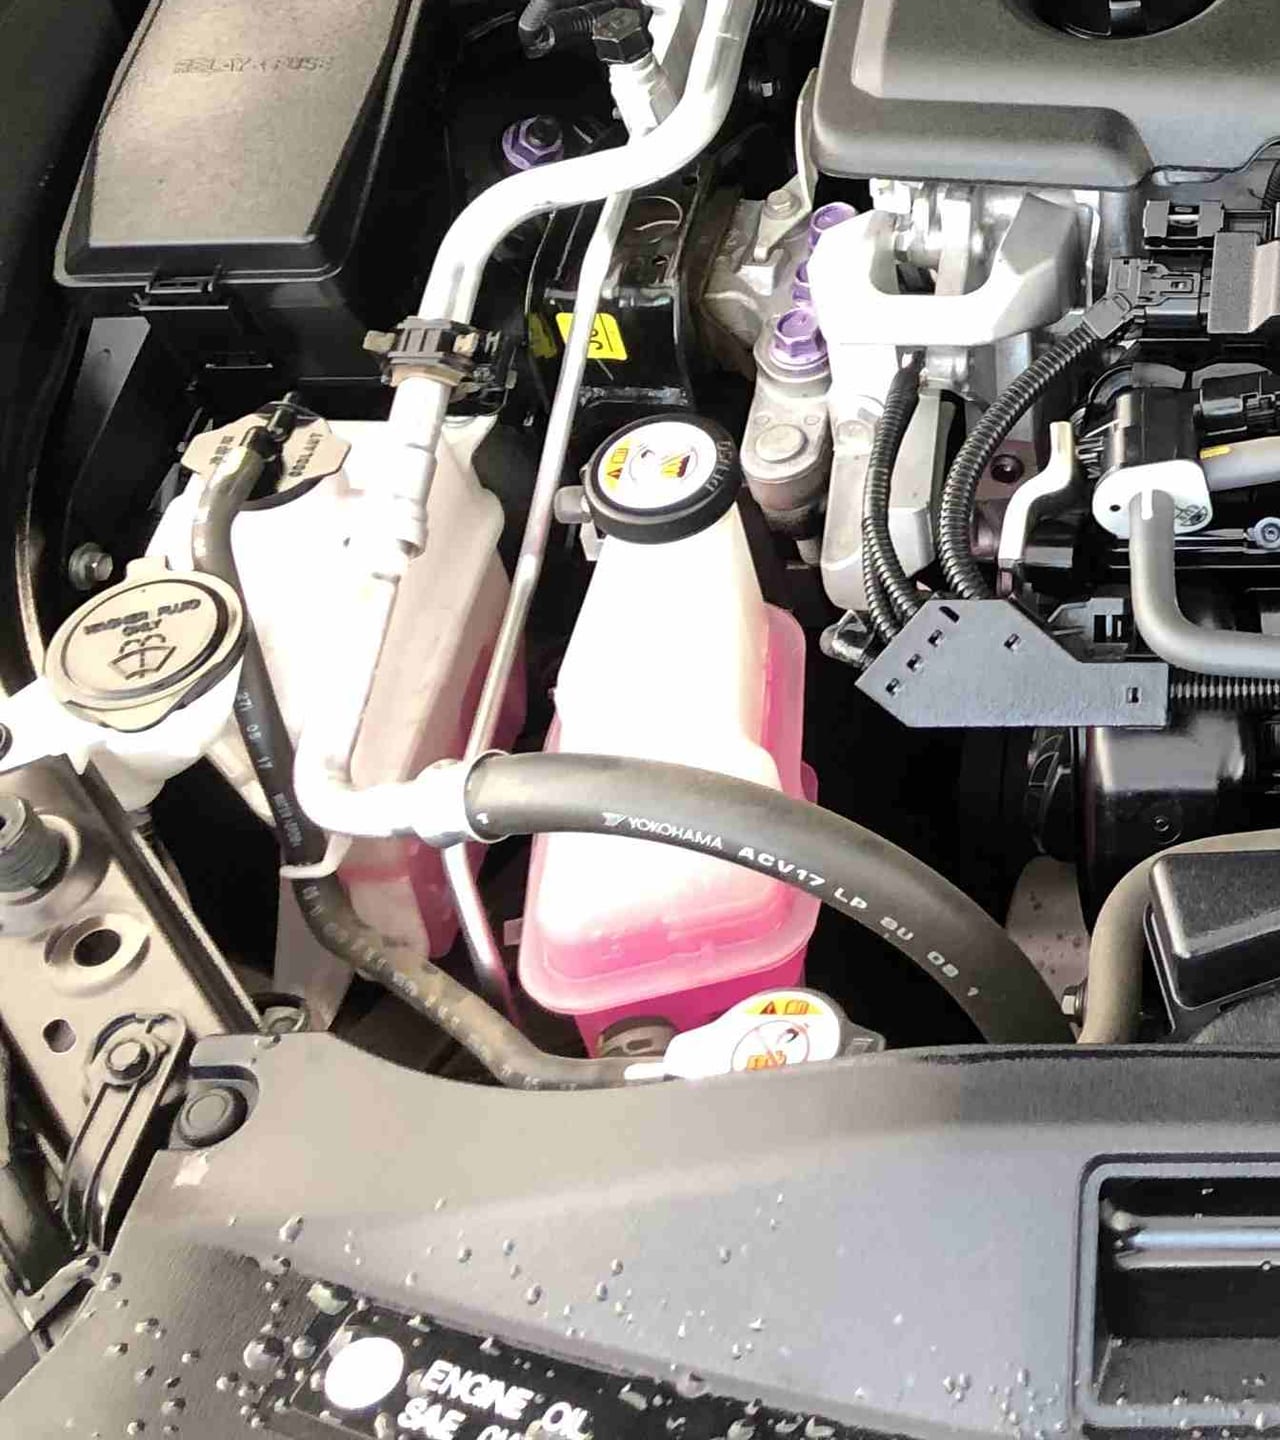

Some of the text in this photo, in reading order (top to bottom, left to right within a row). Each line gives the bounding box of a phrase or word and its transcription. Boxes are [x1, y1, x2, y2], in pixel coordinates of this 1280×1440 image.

[627, 816, 724, 850] YOKOHAMA
[737, 846, 826, 887] ACV17
[834, 886, 868, 909] LP
[397, 1396, 467, 1440] SAE
[419, 1359, 595, 1440] ENGINE OIL
